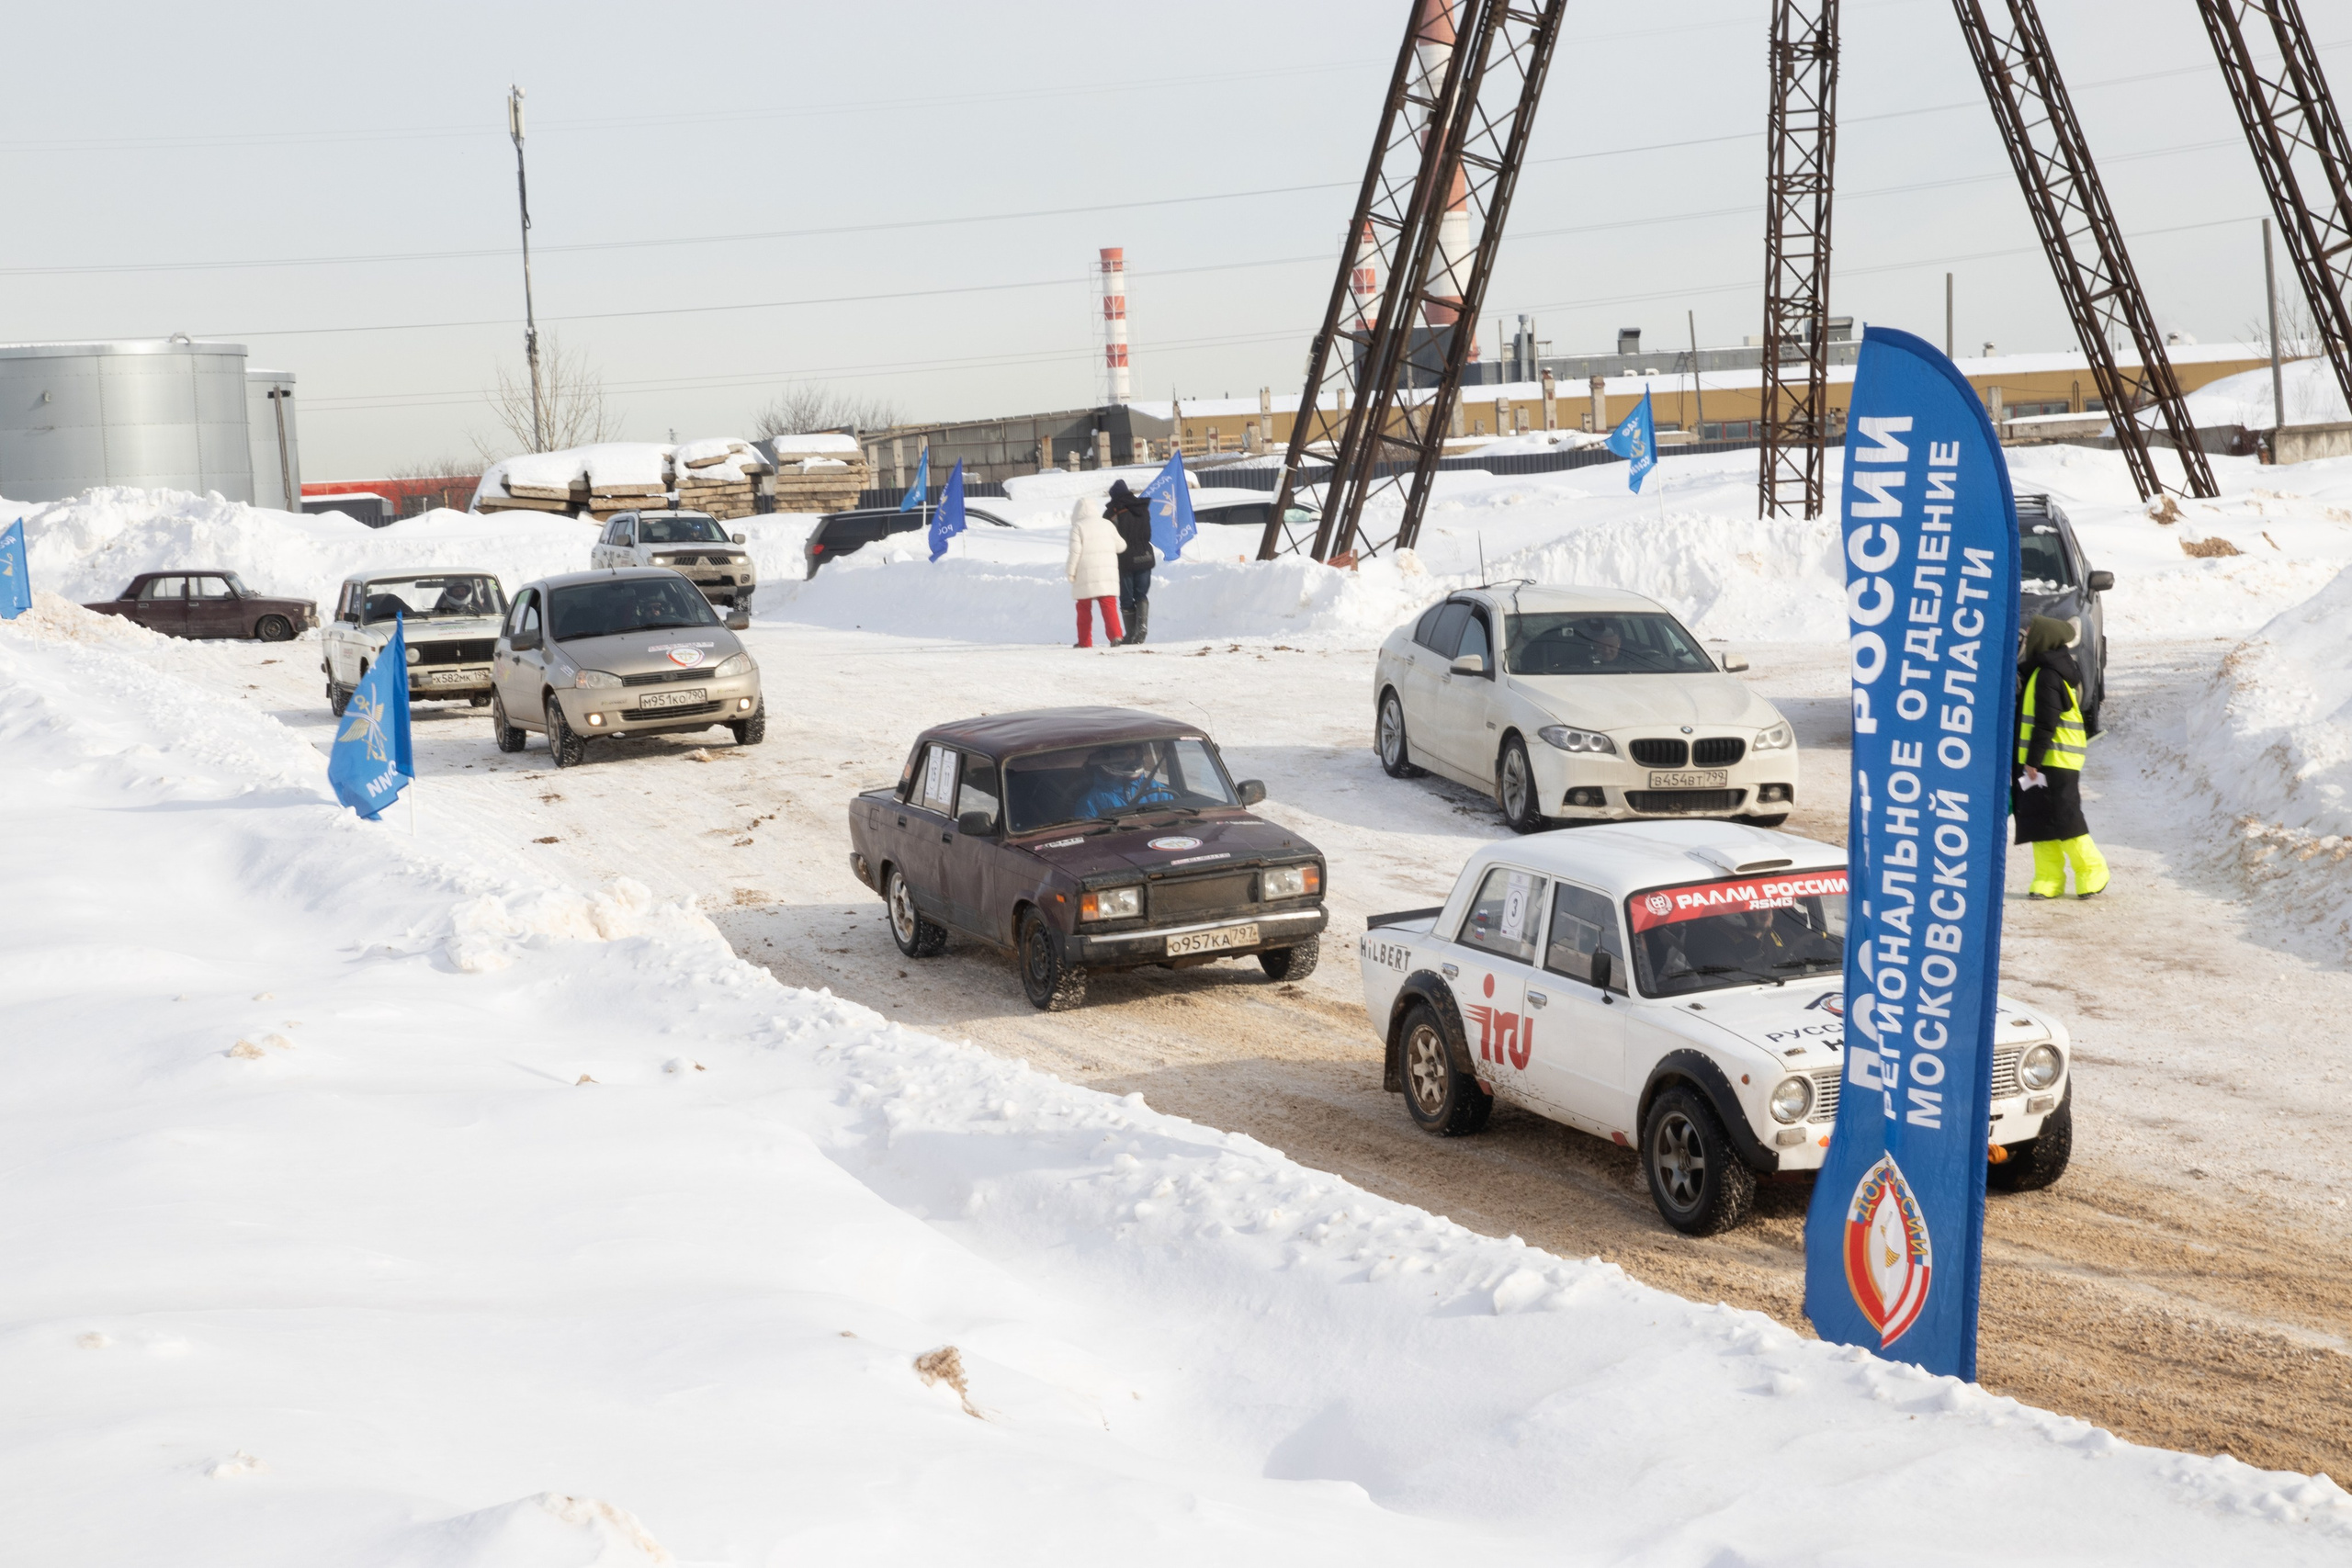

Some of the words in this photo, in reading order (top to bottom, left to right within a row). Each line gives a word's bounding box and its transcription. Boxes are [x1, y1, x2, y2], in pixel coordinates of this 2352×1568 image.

[1848, 416, 1914, 734] РОССИИ
[1896, 441, 1960, 721] ОТДЕЛЕНИЕ
[643, 695, 686, 708] М951КО
[1655, 773, 1702, 786] В454ВТ
[1706, 772, 1724, 782] 799
[1906, 789, 1970, 1129] МОСКОВСКОЙ
[1938, 547, 1995, 770] ОБЛАСТИ
[1511, 897, 1519, 918] 3
[1676, 886, 1758, 909] РАЛЛИ
[1761, 877, 1849, 898] РОССИИ
[1171, 933, 1230, 953] О957КА
[1232, 926, 1254, 941] 797
[1877, 739, 1923, 1120] РЕГИОНАЛЬНОЕ
[1765, 1021, 1844, 1043] РУСС
